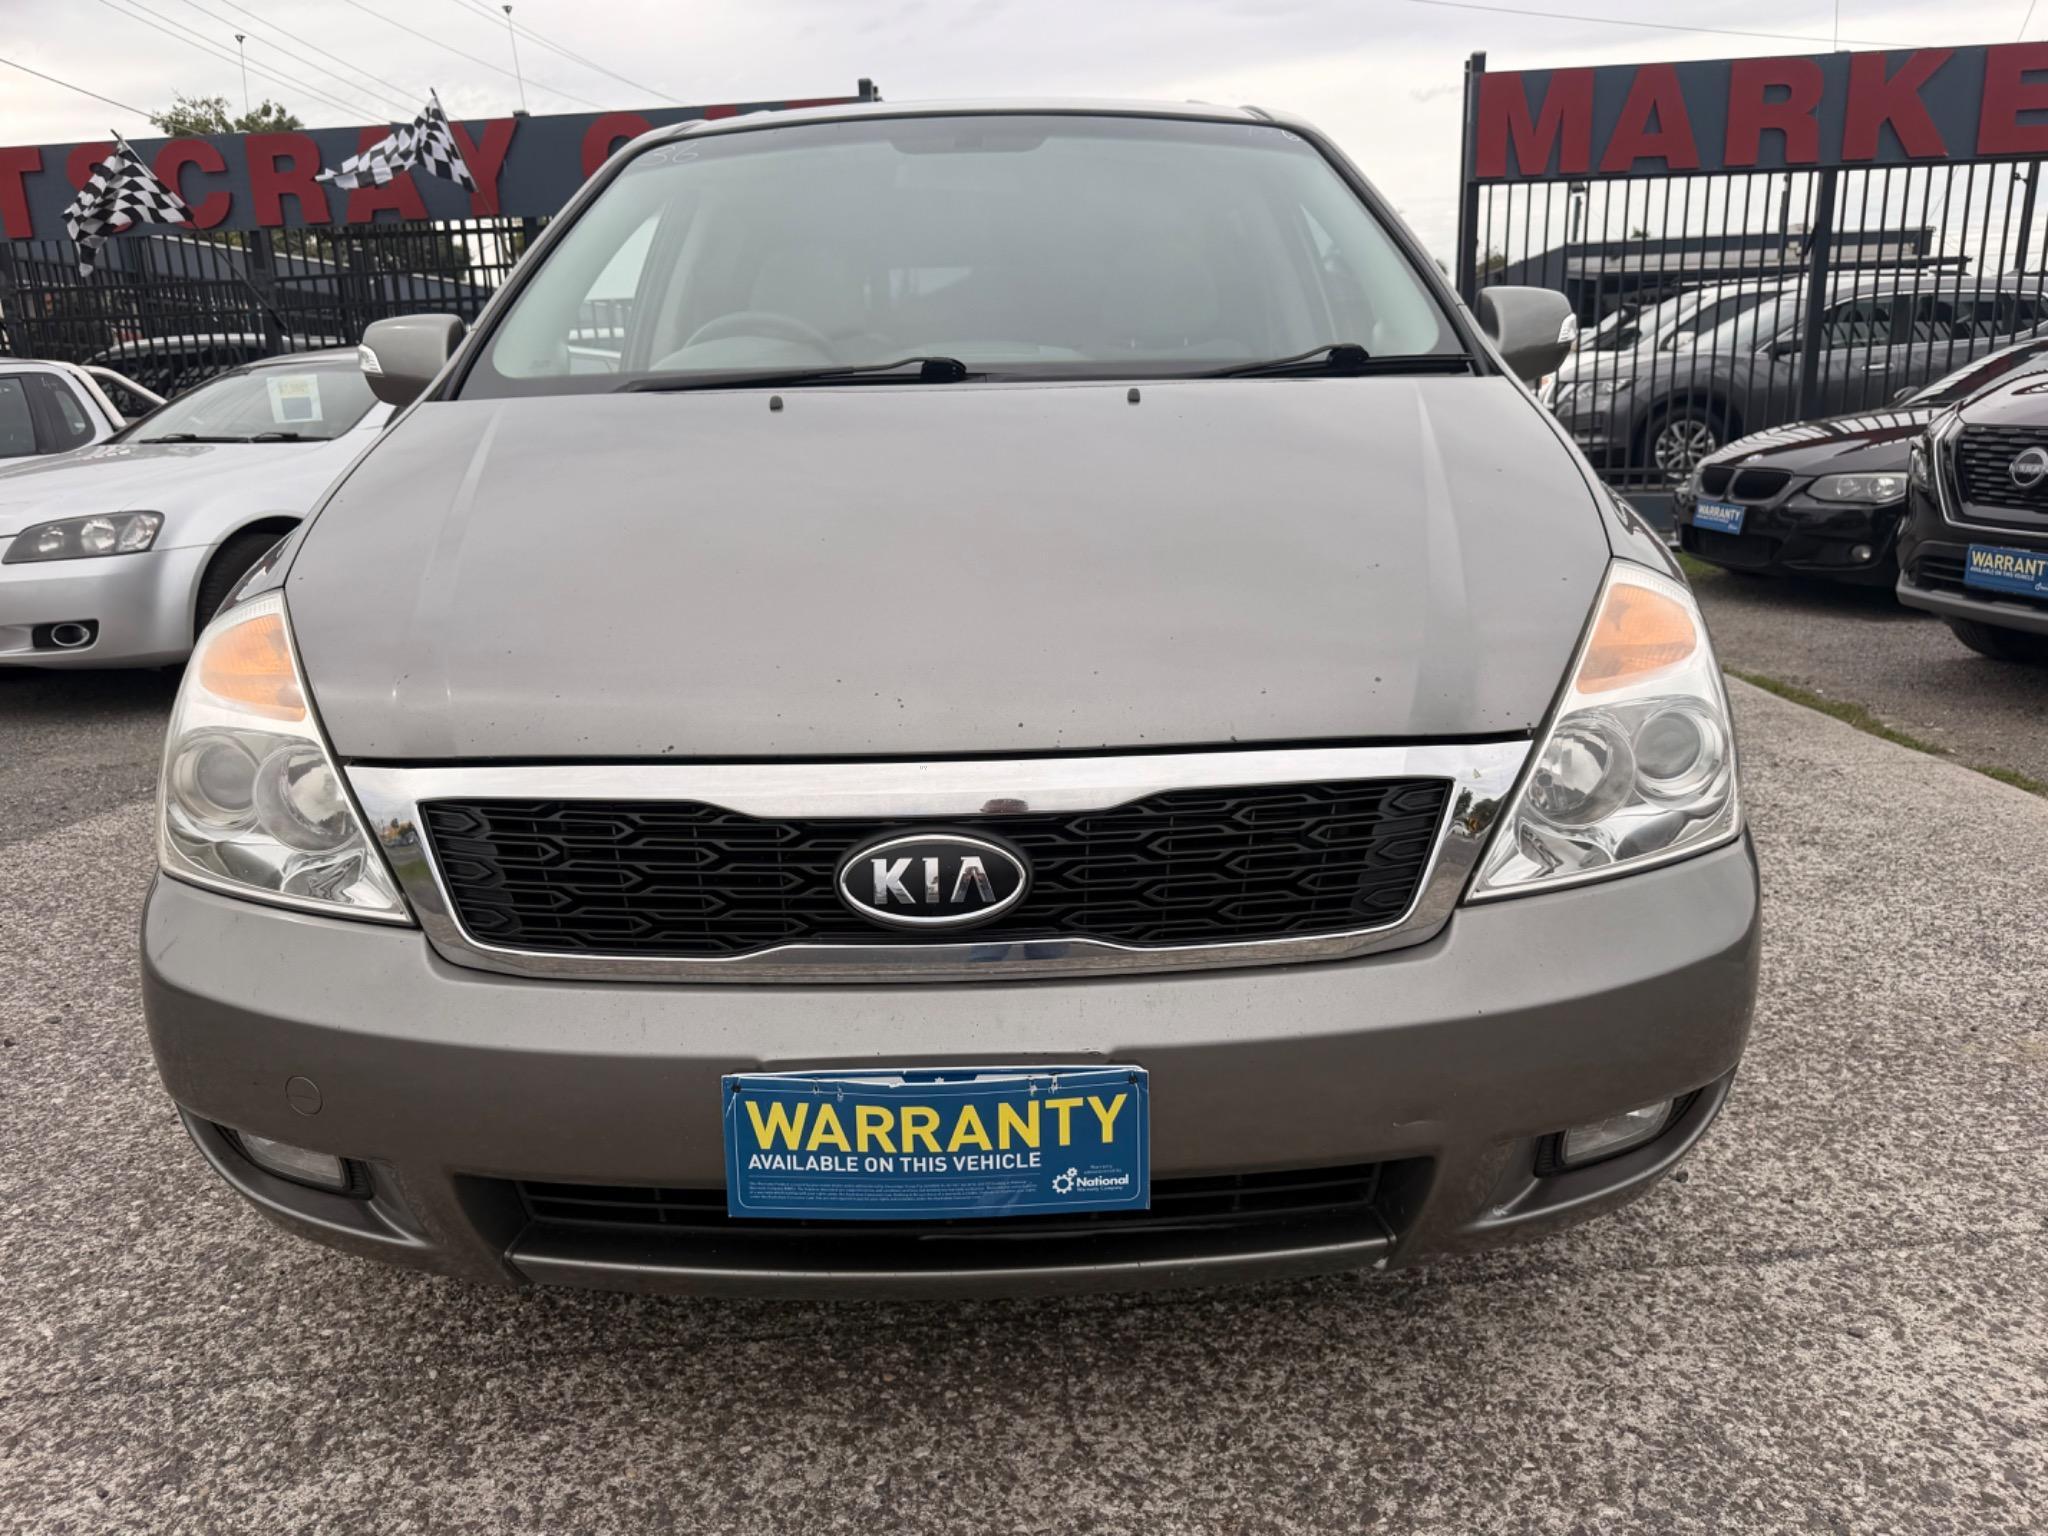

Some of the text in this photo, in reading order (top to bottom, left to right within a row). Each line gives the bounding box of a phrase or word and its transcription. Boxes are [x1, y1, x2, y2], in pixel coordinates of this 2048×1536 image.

[1475, 42, 2048, 178] MARKE
[1972, 550, 2048, 577] WARRANT
[870, 856, 997, 905] KIA
[745, 1093, 1129, 1154] WARRANTY
[748, 1151, 1042, 1173] AVAILABLE ON THIS VEHICLE
[1076, 1173, 1130, 1187] National
